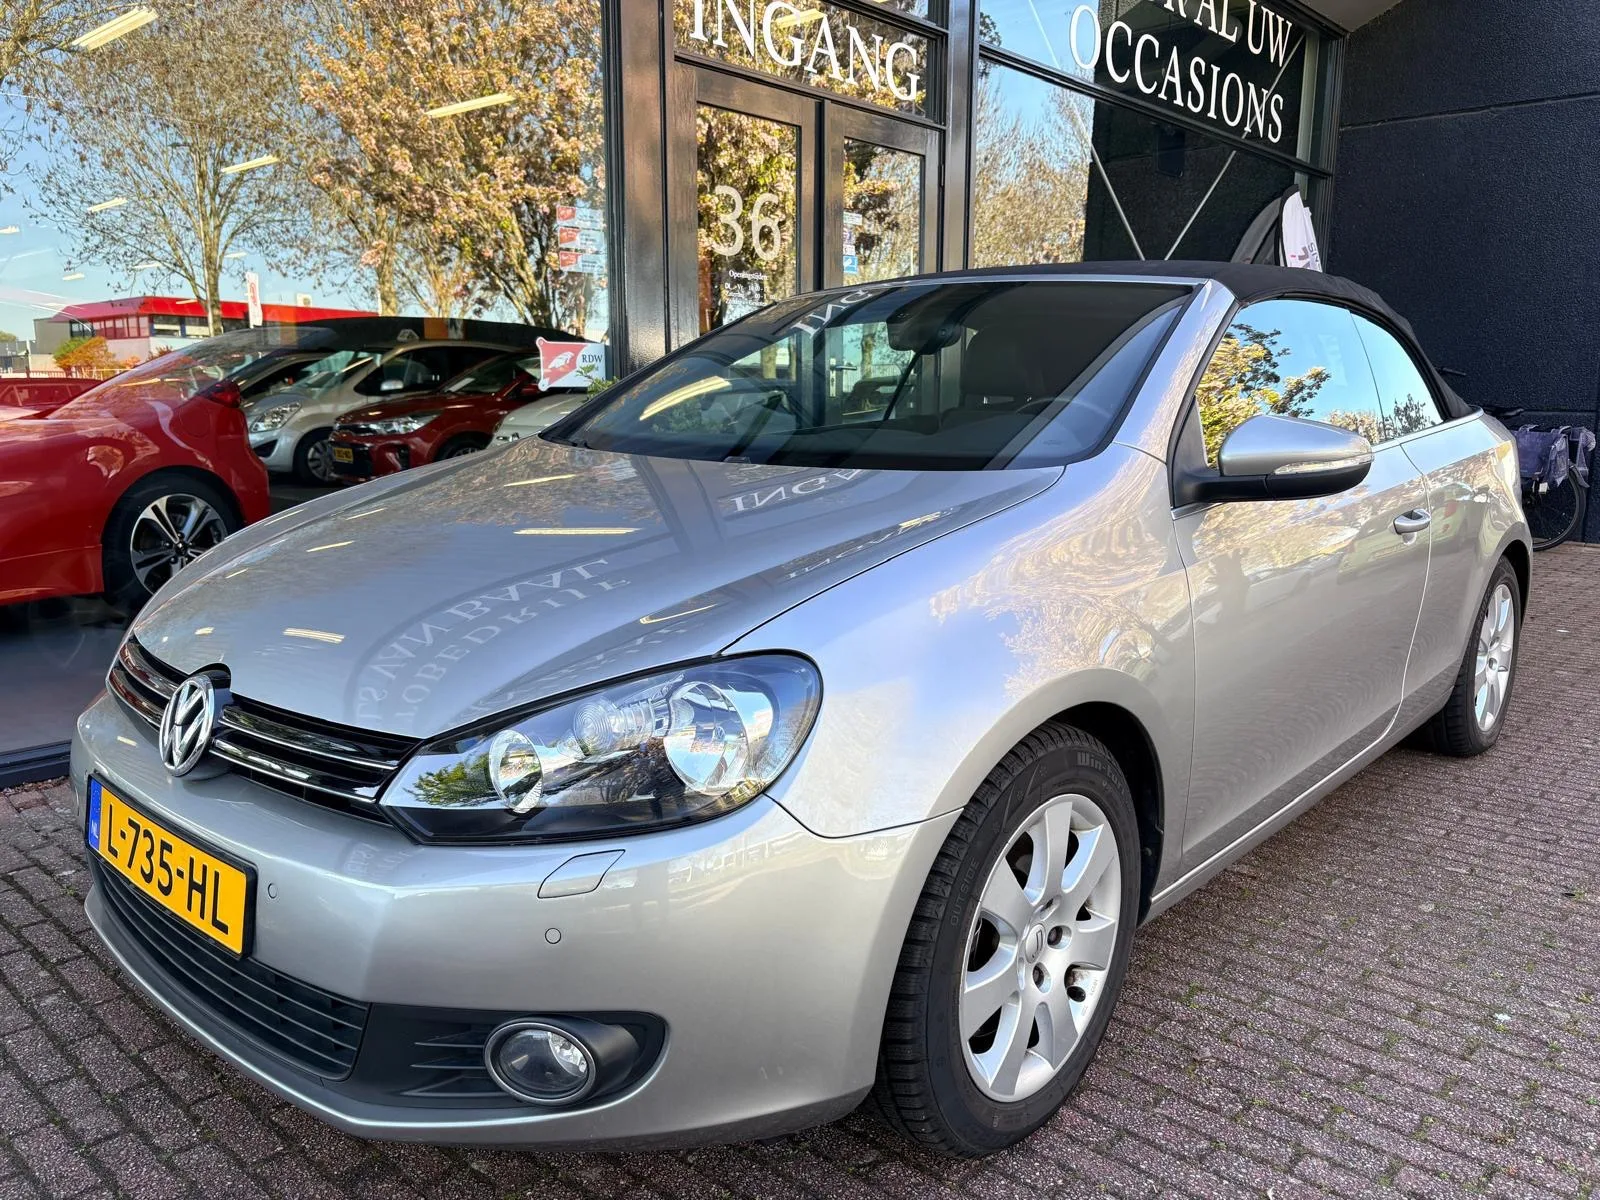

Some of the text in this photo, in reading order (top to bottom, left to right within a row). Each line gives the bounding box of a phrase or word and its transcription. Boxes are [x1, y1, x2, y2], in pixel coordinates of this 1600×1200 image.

[690, 0, 921, 101] INGANG
[1247, 0, 1293, 67] UW
[1070, 5, 1284, 144] OCCASIONS
[712, 185, 781, 261] 36
[582, 354, 603, 364] RDW
[107, 803, 229, 935] L-735-HL
[950, 857, 979, 926] OUTSIDE
